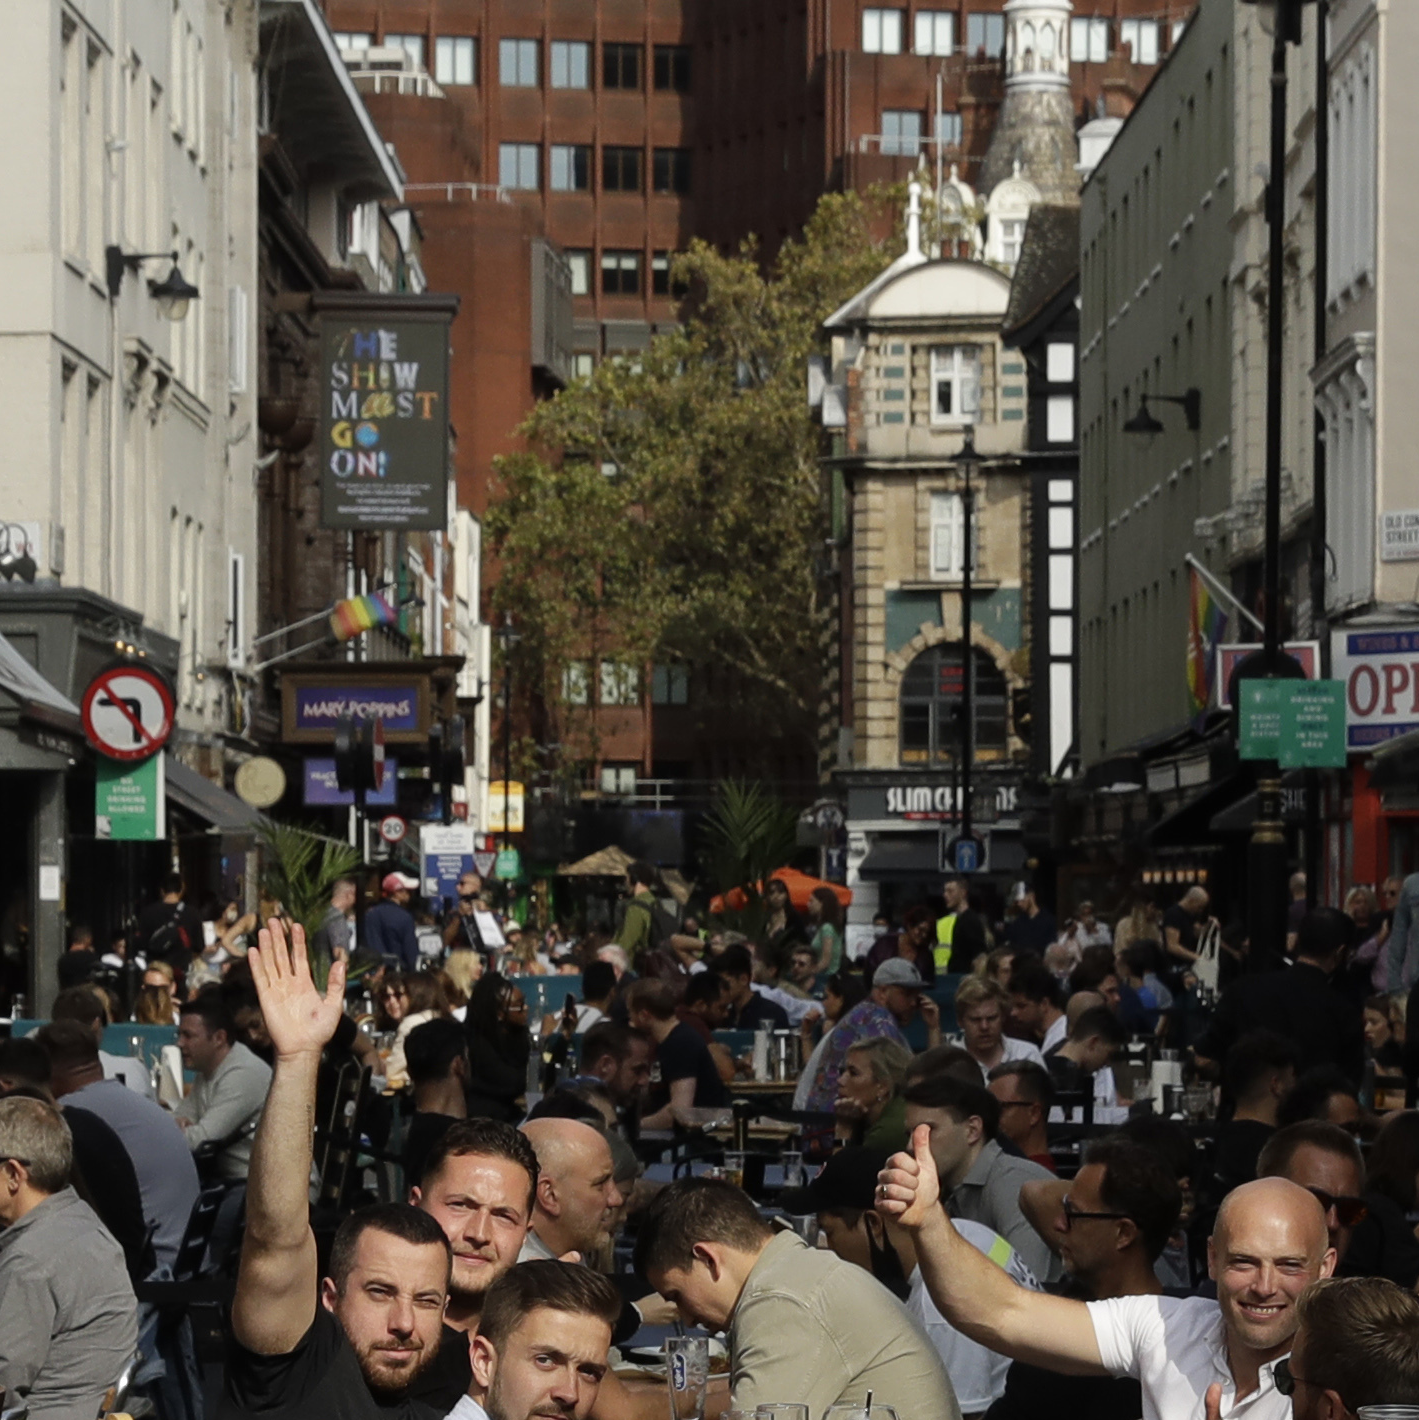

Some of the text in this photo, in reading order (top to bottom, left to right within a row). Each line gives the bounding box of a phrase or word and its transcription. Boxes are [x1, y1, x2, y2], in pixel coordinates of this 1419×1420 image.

[1385, 529, 1419, 544] STREET
[303, 699, 411, 719] MARY POPPINS
[886, 786, 932, 812] SLIM
[384, 822, 404, 834] 20
